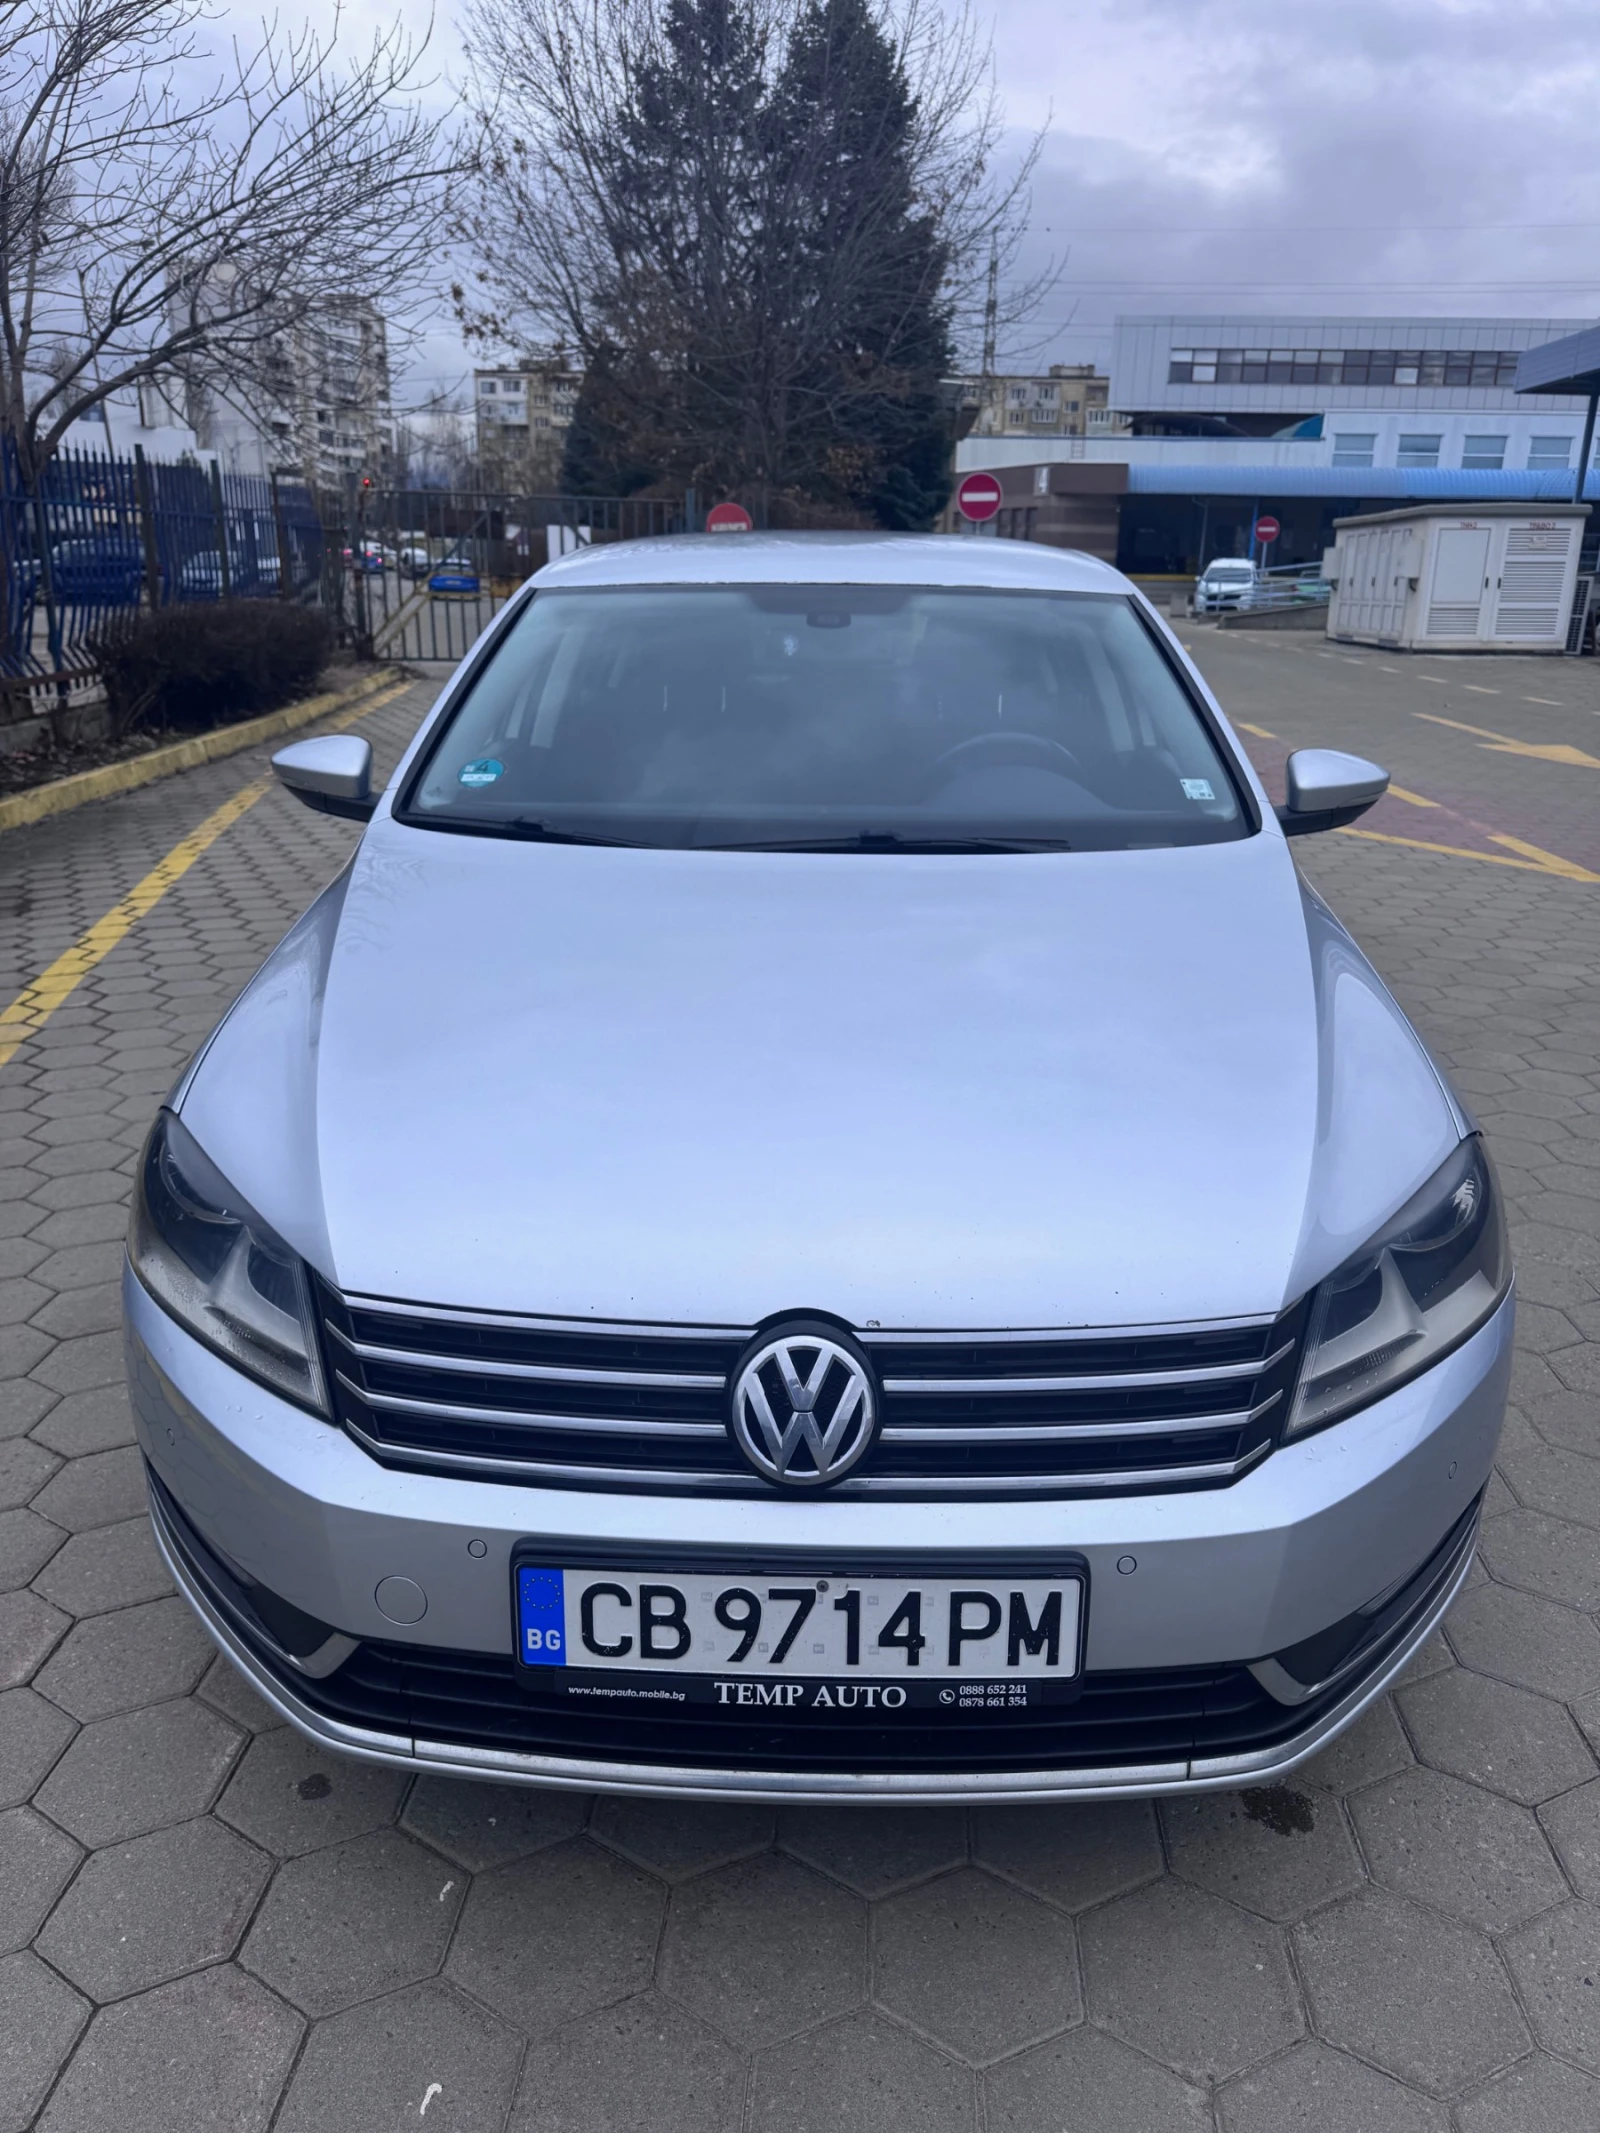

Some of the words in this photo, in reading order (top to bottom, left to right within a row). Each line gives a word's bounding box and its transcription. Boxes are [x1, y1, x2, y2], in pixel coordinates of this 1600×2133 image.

[733, 1336, 874, 1485] VW
[580, 1582, 692, 1660] CB
[714, 1586, 926, 1667] 9714
[947, 1591, 1063, 1667] PM
[527, 1628, 561, 1651] BG
[568, 1686, 686, 1702] www.tempauto.mobile.bg
[713, 1682, 804, 1707] TEMP
[811, 1685, 907, 1708] AUTO
[959, 1685, 985, 1695] 0888
[987, 1685, 1006, 1695] 652
[1008, 1684, 1027, 1694] 241
[959, 1697, 985, 1707] 0878
[987, 1697, 1005, 1707] 661
[1008, 1696, 1027, 1706] 354
